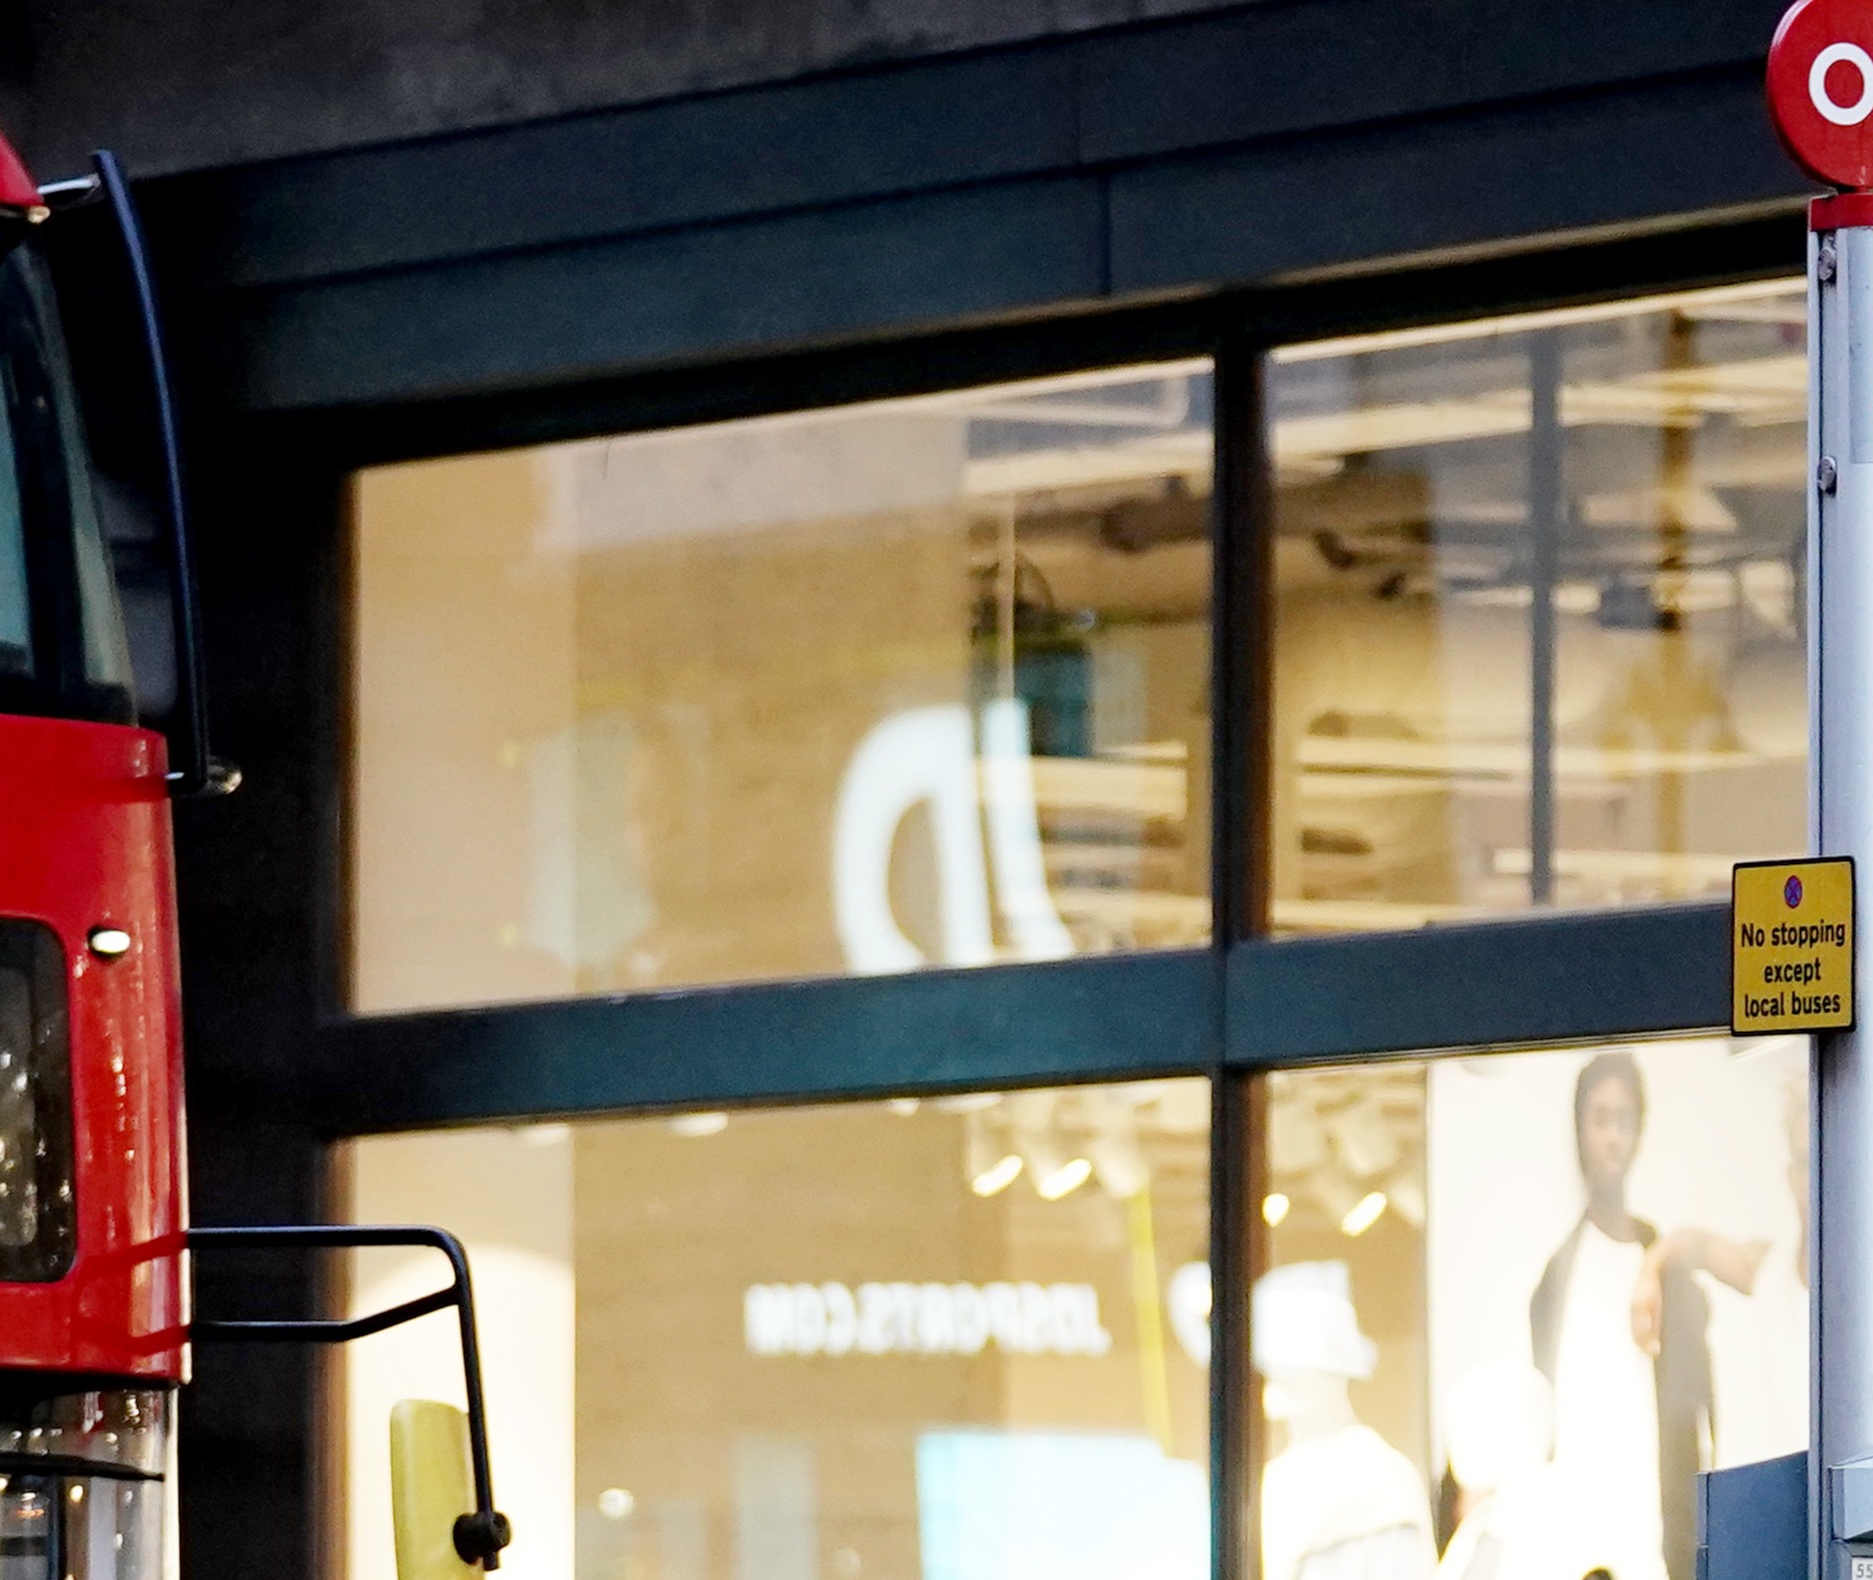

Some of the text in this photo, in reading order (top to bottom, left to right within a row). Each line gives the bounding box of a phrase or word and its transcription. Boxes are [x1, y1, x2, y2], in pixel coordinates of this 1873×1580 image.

[1741, 922, 1846, 948] No stopping
[1764, 957, 1822, 986] except
[1744, 991, 1841, 1018] local buses
[1856, 1563, 1873, 1579] 55
